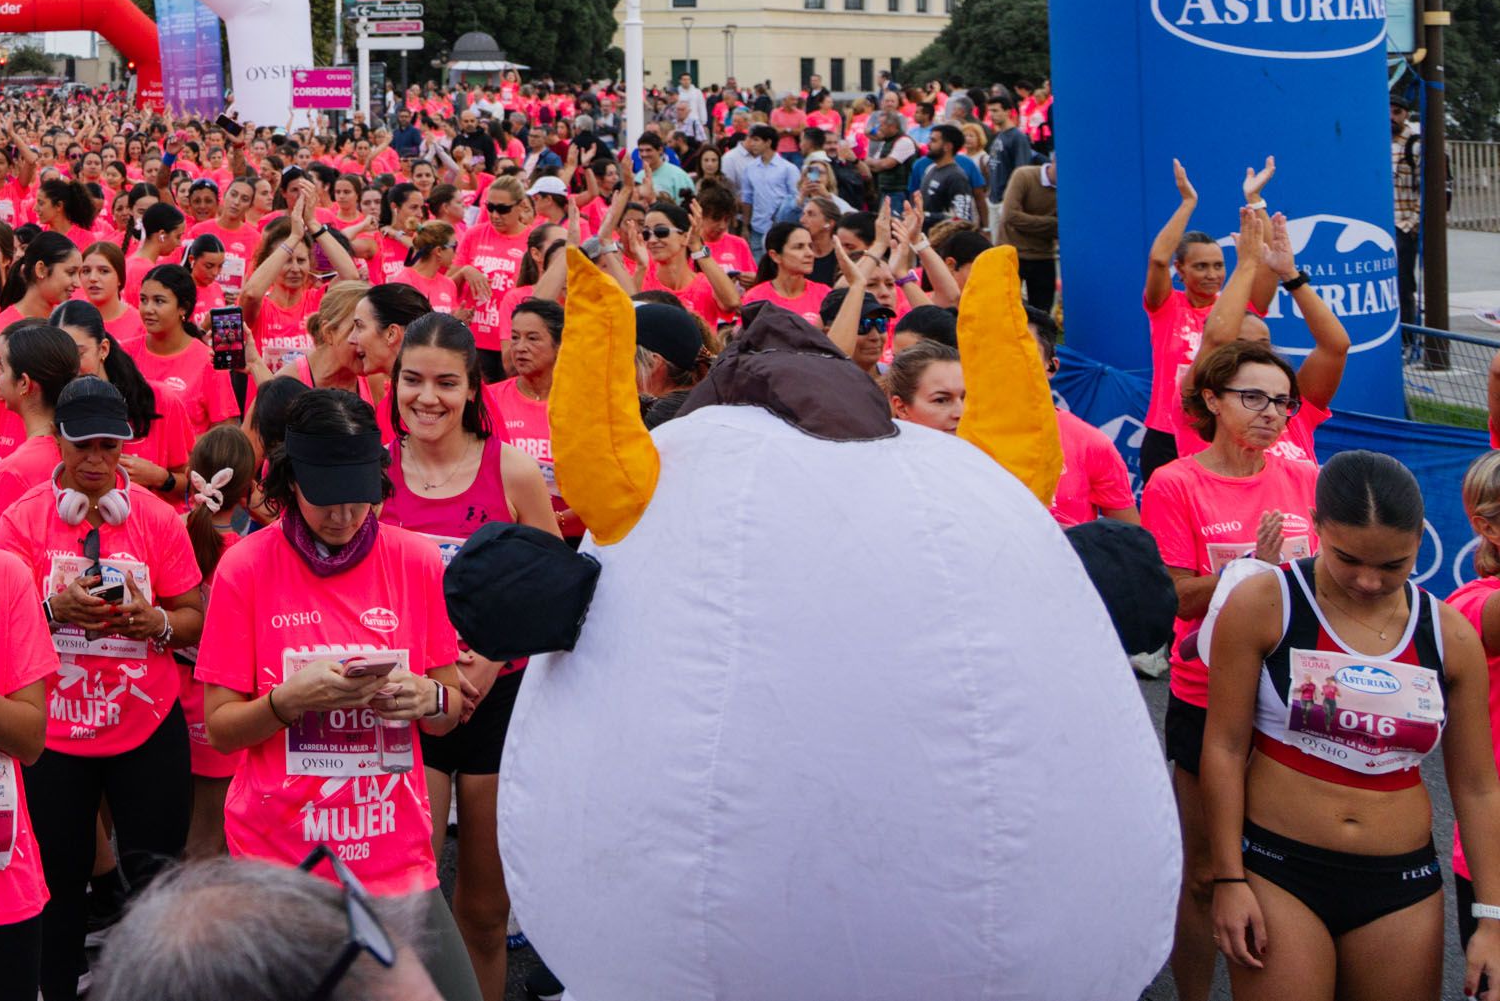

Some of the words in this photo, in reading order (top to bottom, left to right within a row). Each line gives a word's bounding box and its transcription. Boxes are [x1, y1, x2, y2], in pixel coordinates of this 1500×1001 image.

[293, 87, 352, 97] CORREDORAS
[271, 610, 322, 629] OYSHO
[56, 639, 90, 650] OYSHO
[1301, 660, 1330, 670] SUMA
[1341, 671, 1397, 690] ASTURIANA
[50, 701, 121, 728] MUJER
[329, 708, 375, 729] 016
[1339, 710, 1397, 737] 016
[299, 743, 328, 751] CARRERA
[330, 743, 338, 752] DE
[340, 744, 348, 752] LA
[350, 744, 369, 752] MUJER
[1301, 736, 1348, 760] OYSHO
[1335, 734, 1345, 743] DE
[1346, 737, 1356, 747] LA
[302, 757, 344, 769] OYSHO
[353, 775, 382, 805] LA
[302, 800, 396, 843] MUJER
[337, 841, 370, 862] 2026
[1251, 845, 1284, 861] GALEGO
